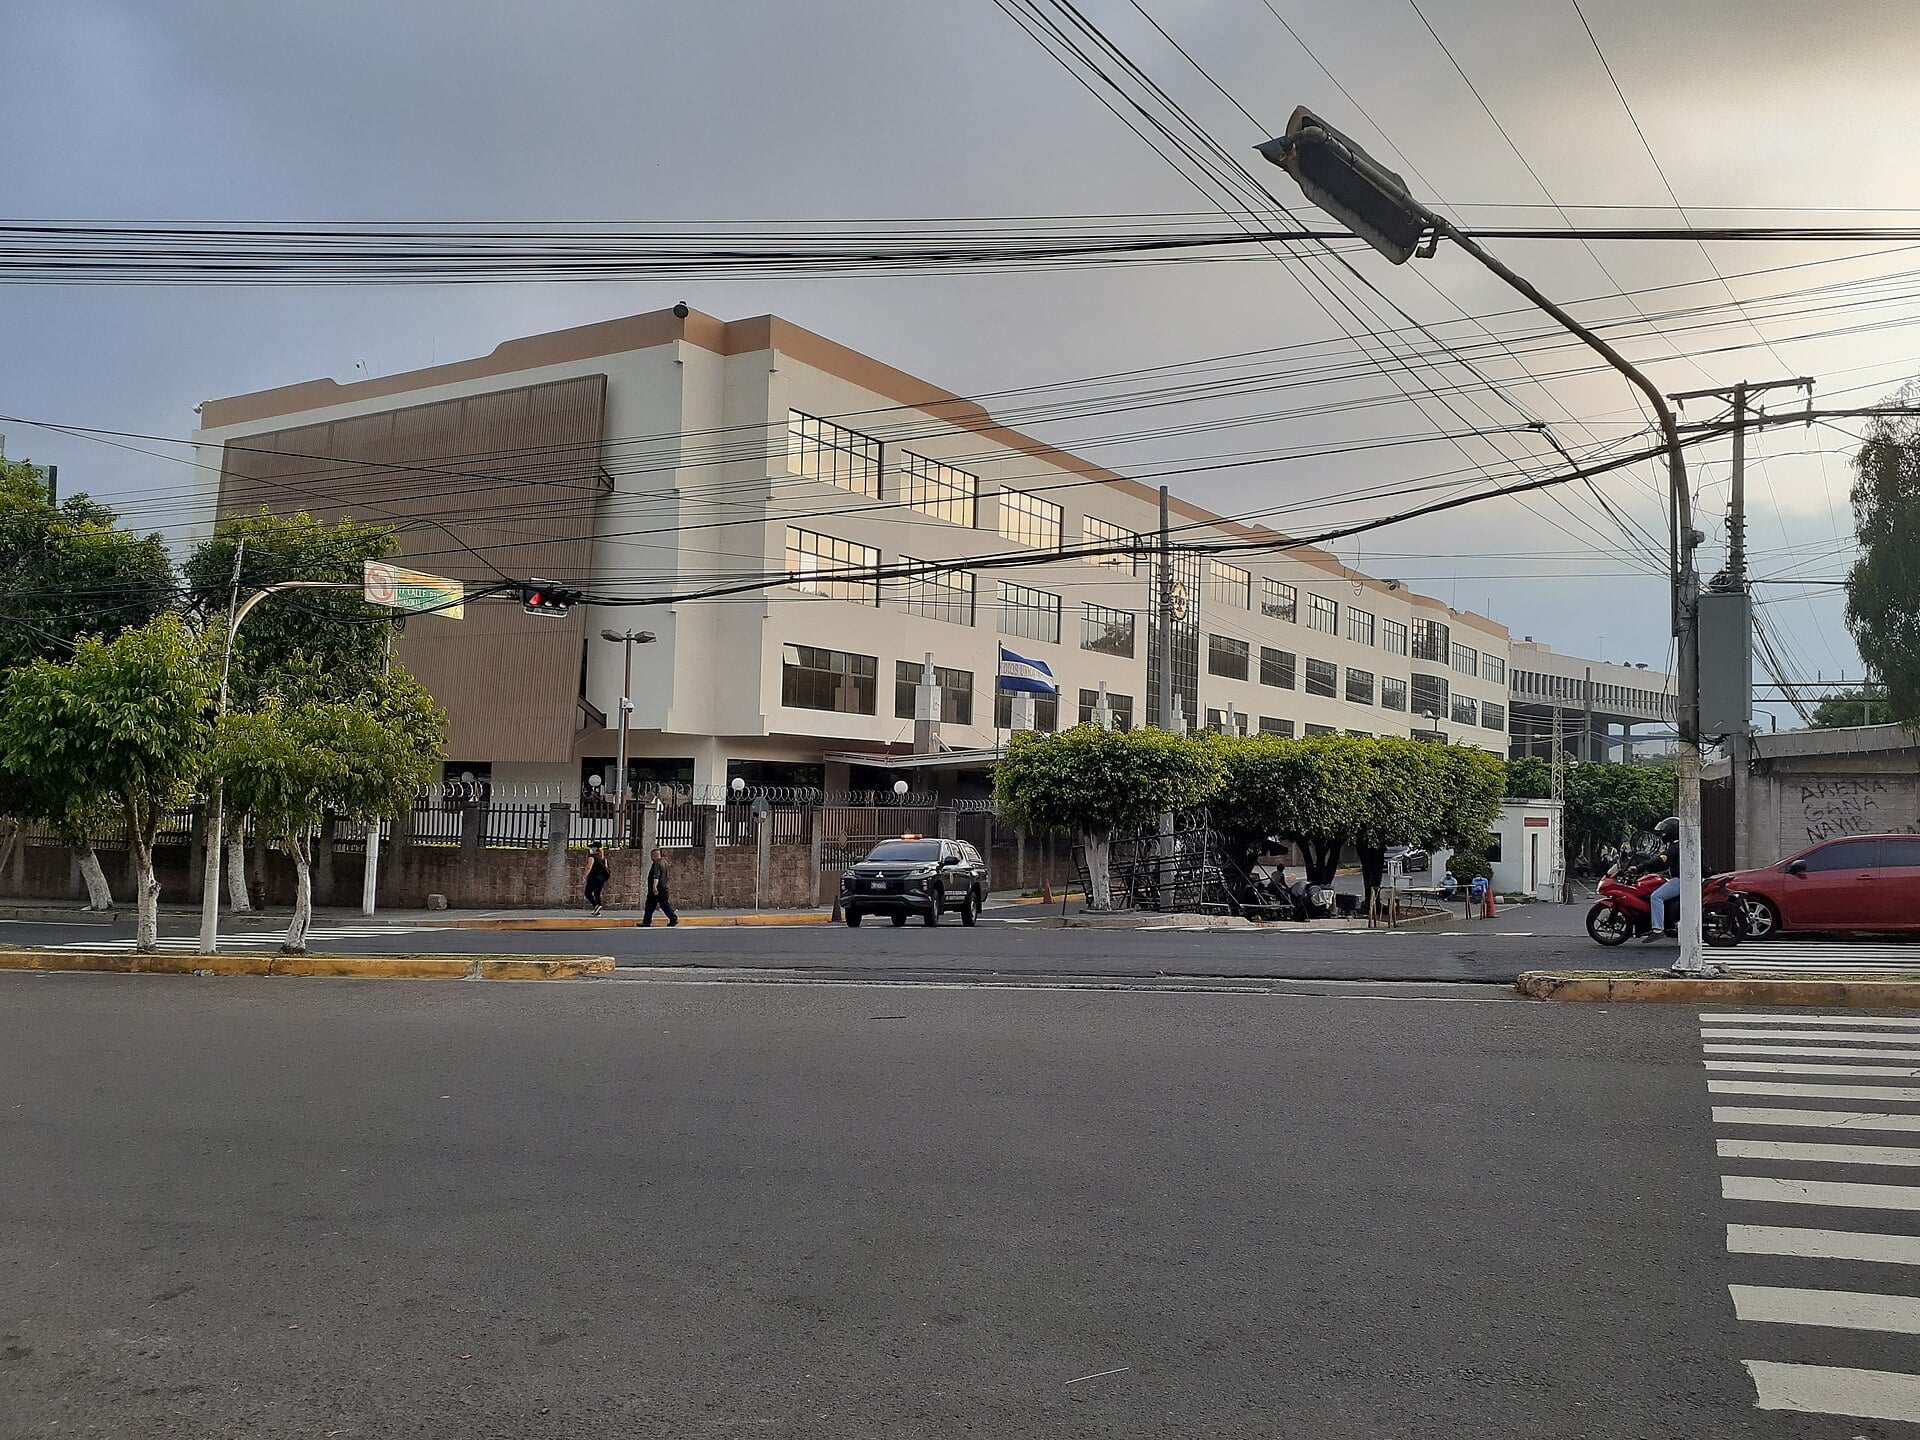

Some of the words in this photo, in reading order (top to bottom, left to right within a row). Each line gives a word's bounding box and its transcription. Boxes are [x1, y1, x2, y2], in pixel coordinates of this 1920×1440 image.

[407, 588, 427, 598] CALLE
[1003, 663, 1019, 675] DIOS
[1801, 780, 1887, 803] ARENA
[1804, 796, 1879, 822] GANA
[1806, 816, 1872, 845] NAYIB
